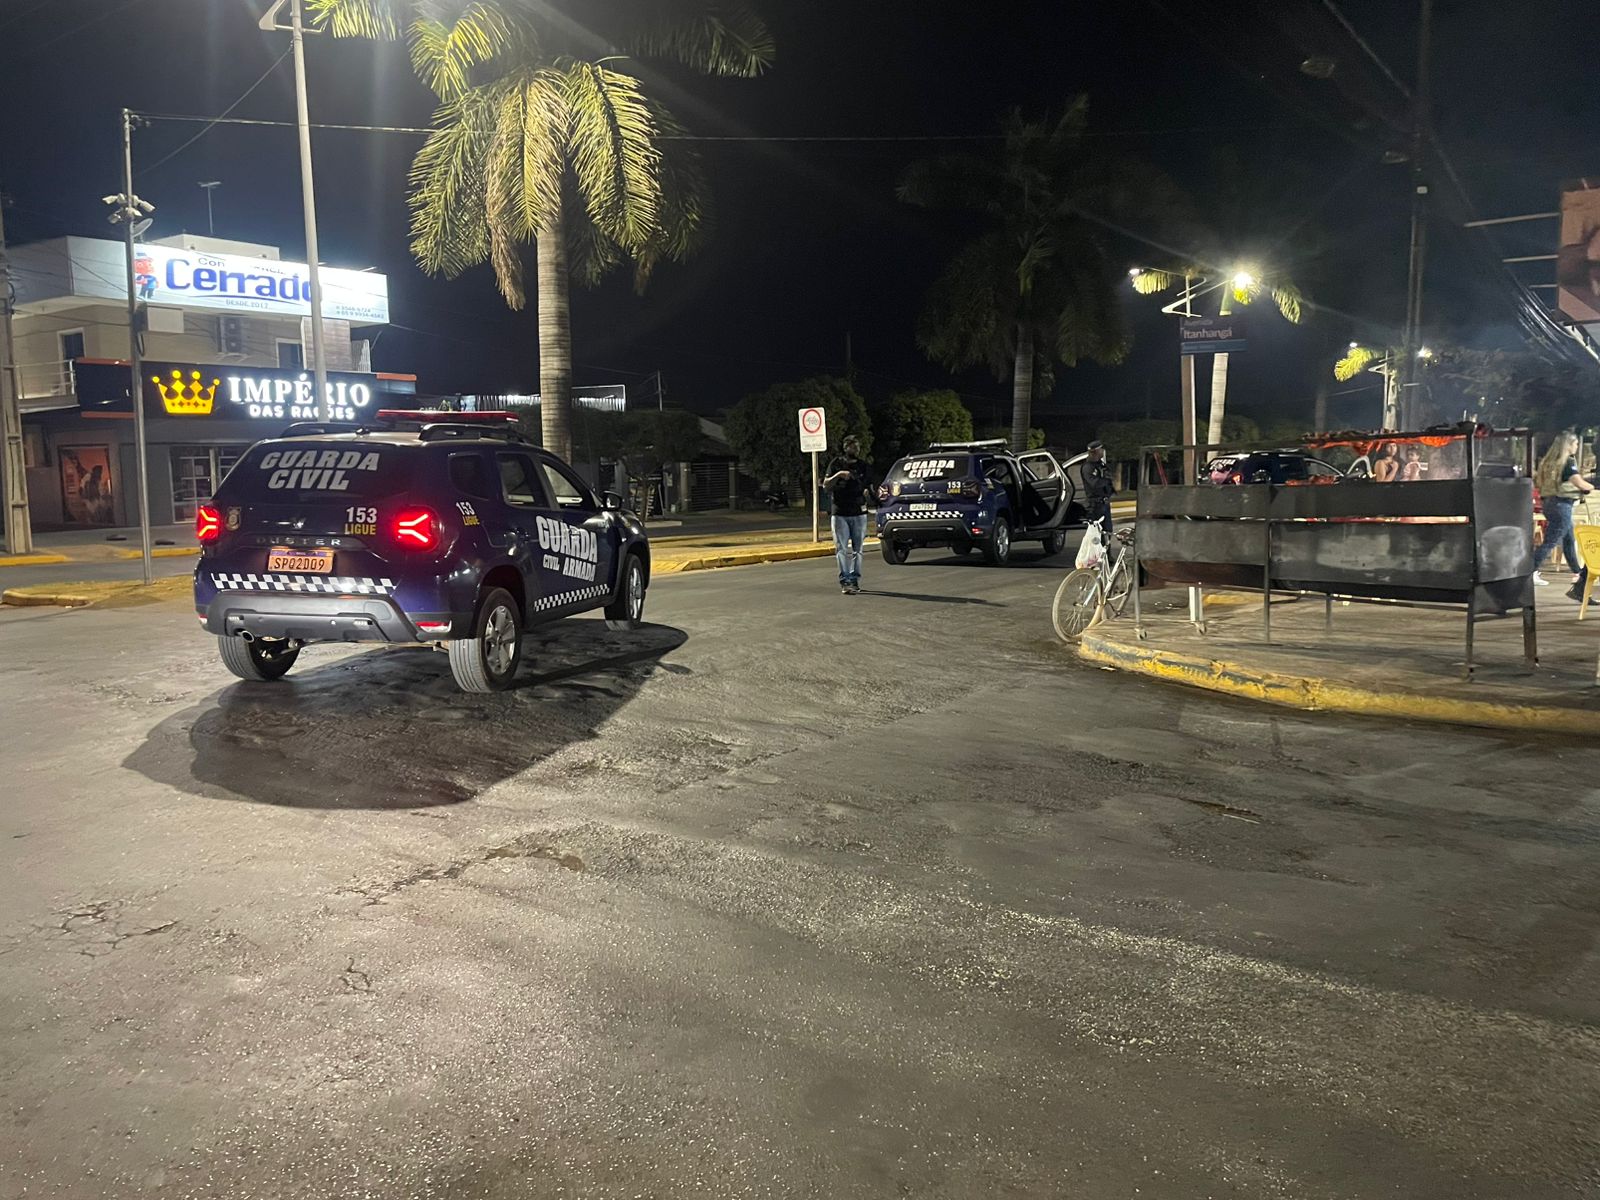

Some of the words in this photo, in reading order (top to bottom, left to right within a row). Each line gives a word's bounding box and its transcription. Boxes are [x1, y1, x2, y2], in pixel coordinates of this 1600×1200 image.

[1183, 327, 1232, 339] Itanhangá
[227, 372, 370, 407] IMPÉRIO
[249, 404, 285, 418] DAS
[260, 450, 380, 470] GUARDA
[903, 460, 955, 471] GUARDA
[267, 469, 350, 490] CIVIL
[908, 468, 944, 479] CIVIL
[947, 481, 961, 489] 153
[346, 507, 378, 523] 153
[456, 501, 476, 516] 153
[462, 515, 481, 527] LIGUE
[344, 523, 377, 535] LIGUE
[535, 515, 598, 563] GUARDA
[273, 557, 325, 571] SPQ2D09
[543, 554, 560, 571] CIVIL
[562, 556, 597, 582] ARMADA
